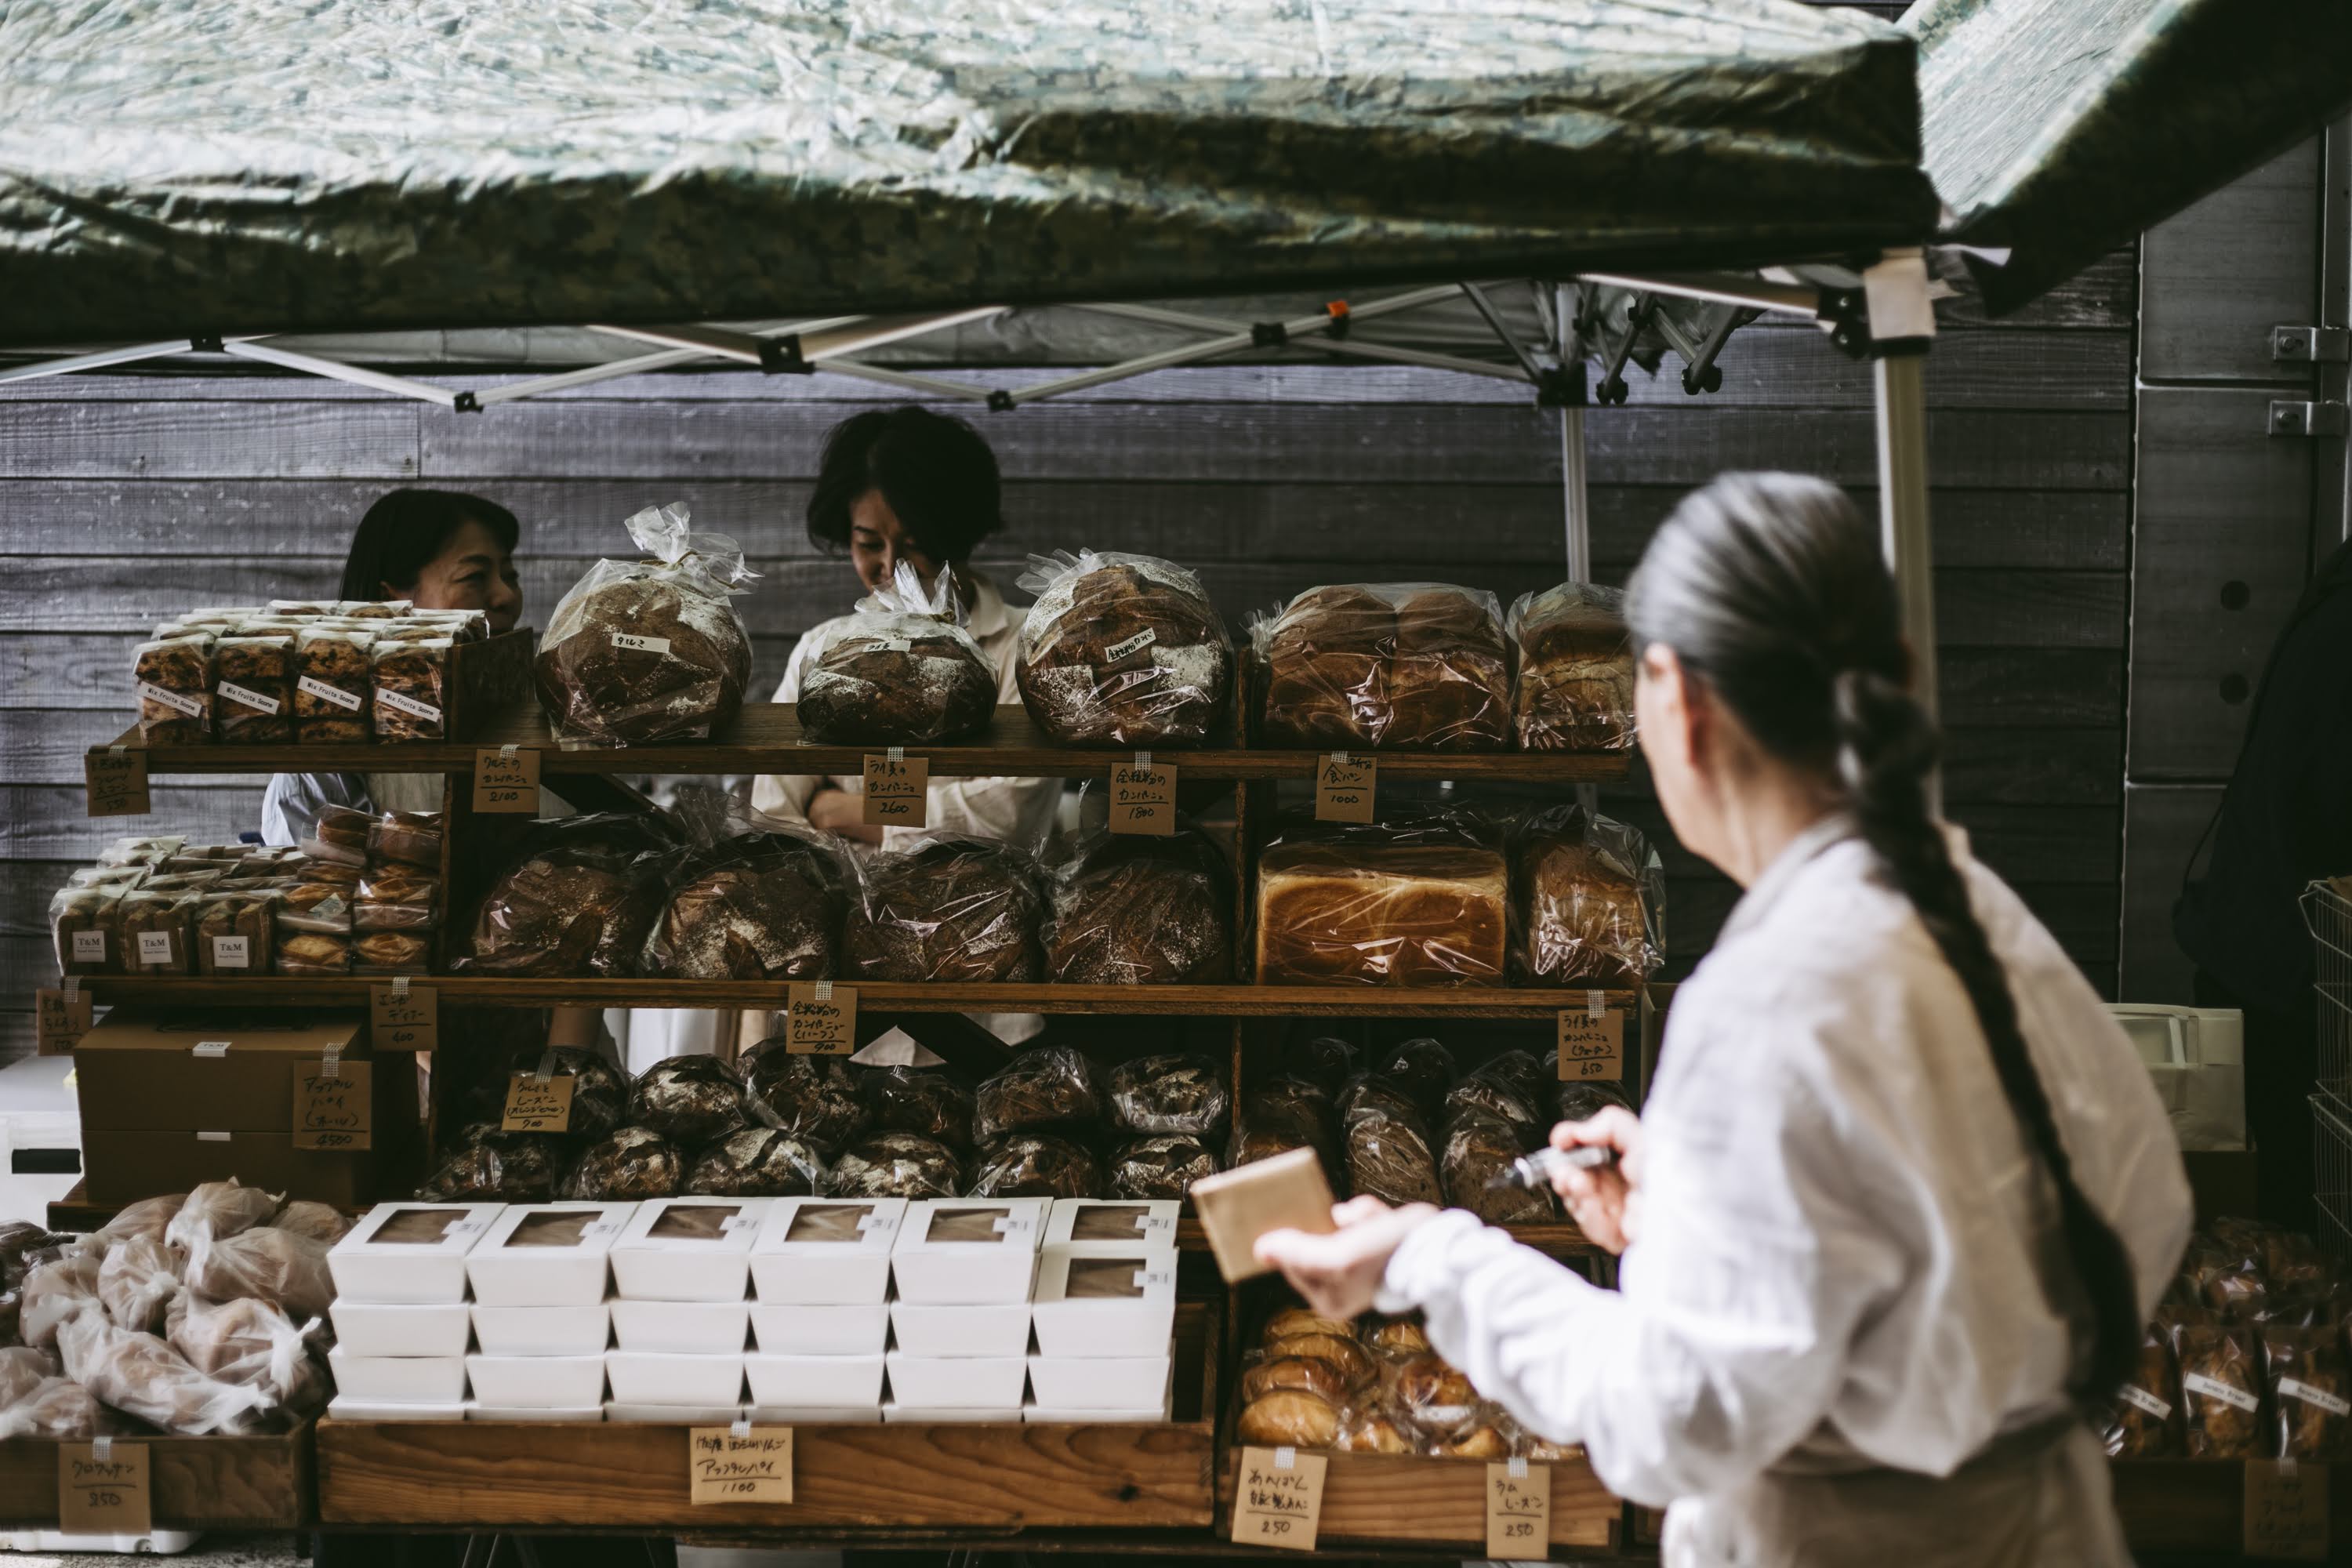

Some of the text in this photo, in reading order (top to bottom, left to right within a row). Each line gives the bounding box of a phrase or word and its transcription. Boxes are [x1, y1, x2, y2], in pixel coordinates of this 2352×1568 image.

[617, 637, 645, 648] クルミ
[147, 687, 158, 695] Mix
[159, 691, 178, 704] Fruits
[307, 681, 317, 690] Mix
[318, 686, 337, 698] Fruits
[238, 691, 256, 702] Fruits
[397, 698, 416, 710] Fruits
[1323, 763, 1362, 784] 食パン
[488, 791, 519, 802] 2100
[880, 801, 909, 814] 2600
[1129, 807, 1154, 819] 1800
[77, 938, 100, 946] T&M
[814, 1042, 837, 1053] 900
[1581, 1062, 1603, 1076] 650
[303, 1076, 354, 1092] アップル
[517, 1096, 557, 1106] レーズン
[315, 1134, 353, 1145] 4500
[721, 1482, 756, 1493] 1100
[1261, 1521, 1291, 1535] 250
[1505, 1523, 1534, 1537] 250
